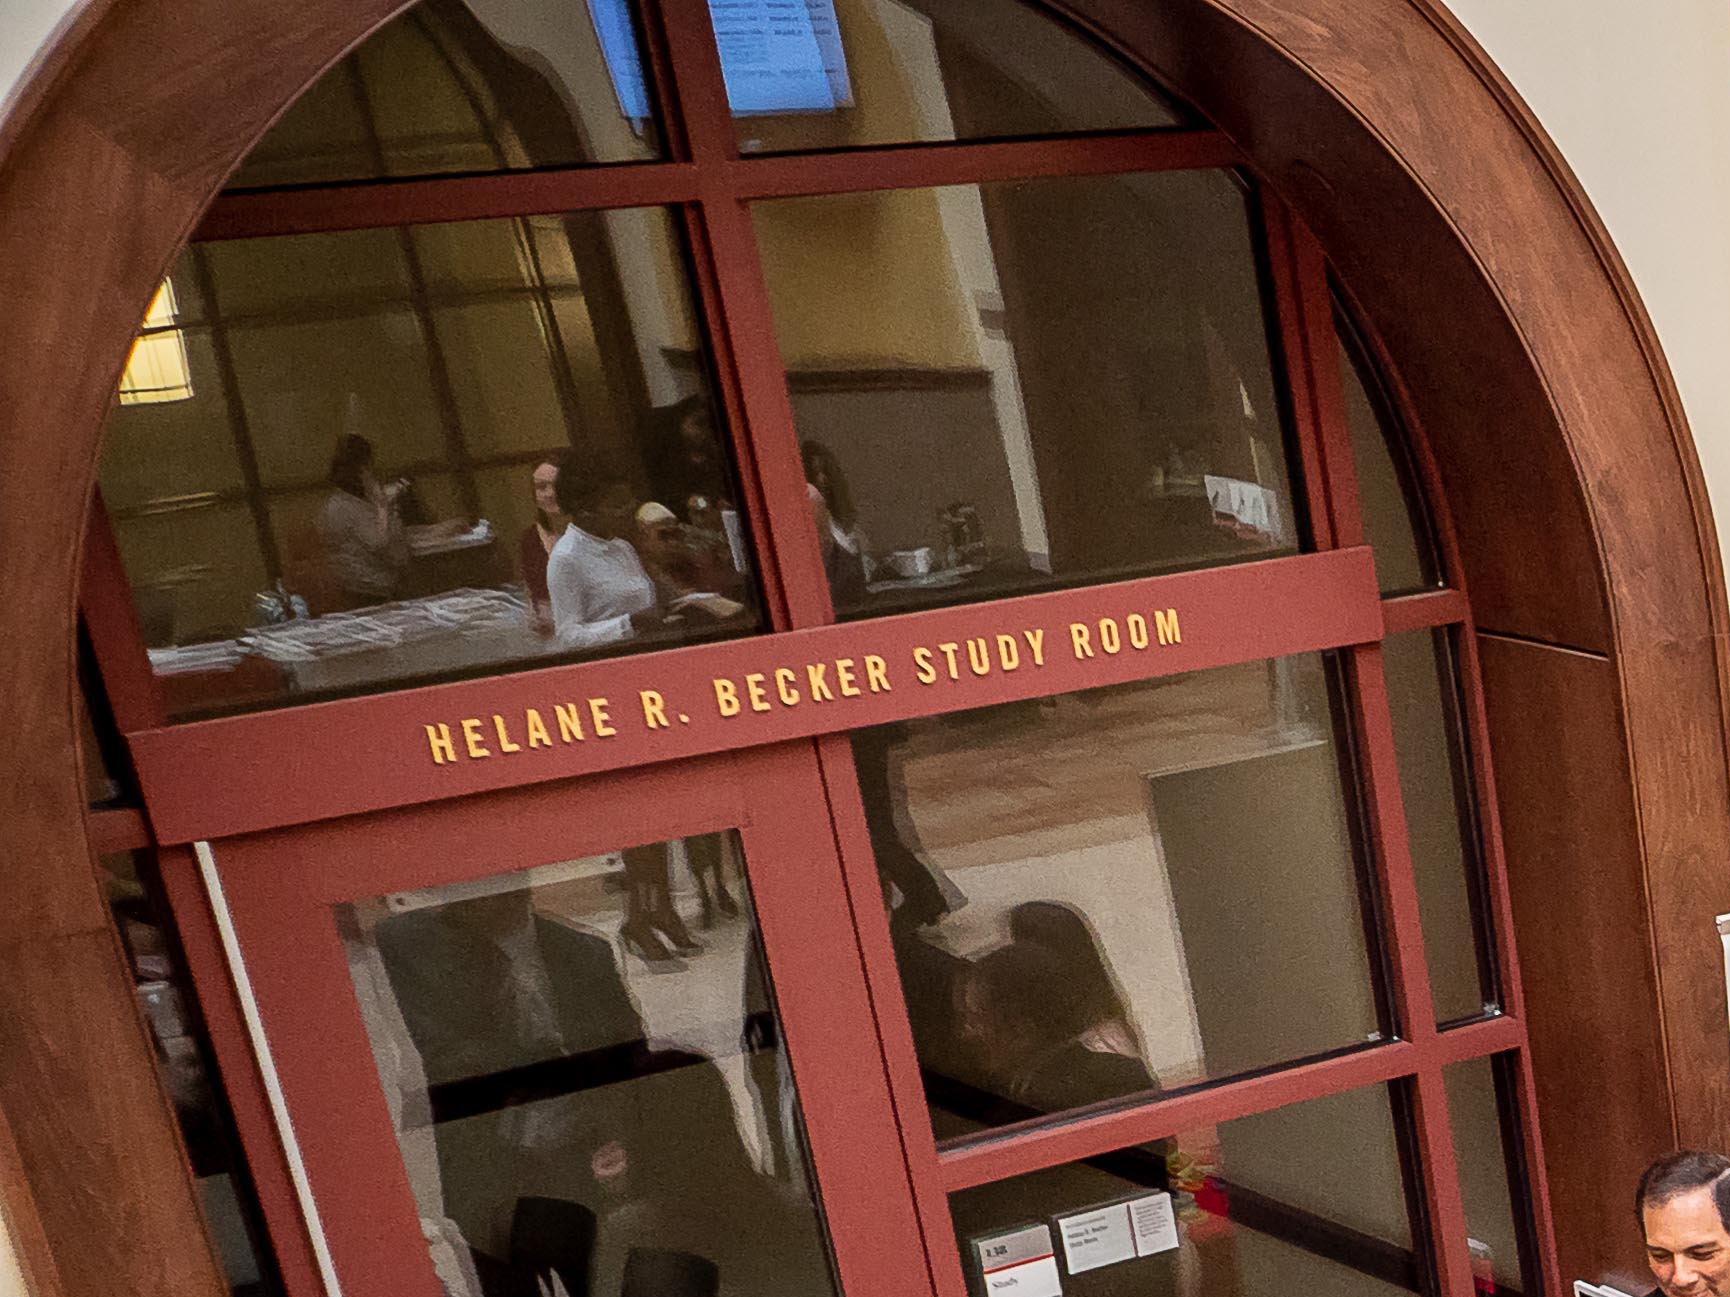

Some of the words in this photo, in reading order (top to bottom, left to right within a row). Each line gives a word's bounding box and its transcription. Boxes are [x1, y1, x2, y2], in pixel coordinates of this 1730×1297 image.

[424, 698, 617, 766] HELANE
[640, 690, 693, 731] R.
[711, 654, 894, 718] BECKER
[913, 627, 1048, 686] STUDY
[1070, 608, 1184, 659] ROOM
